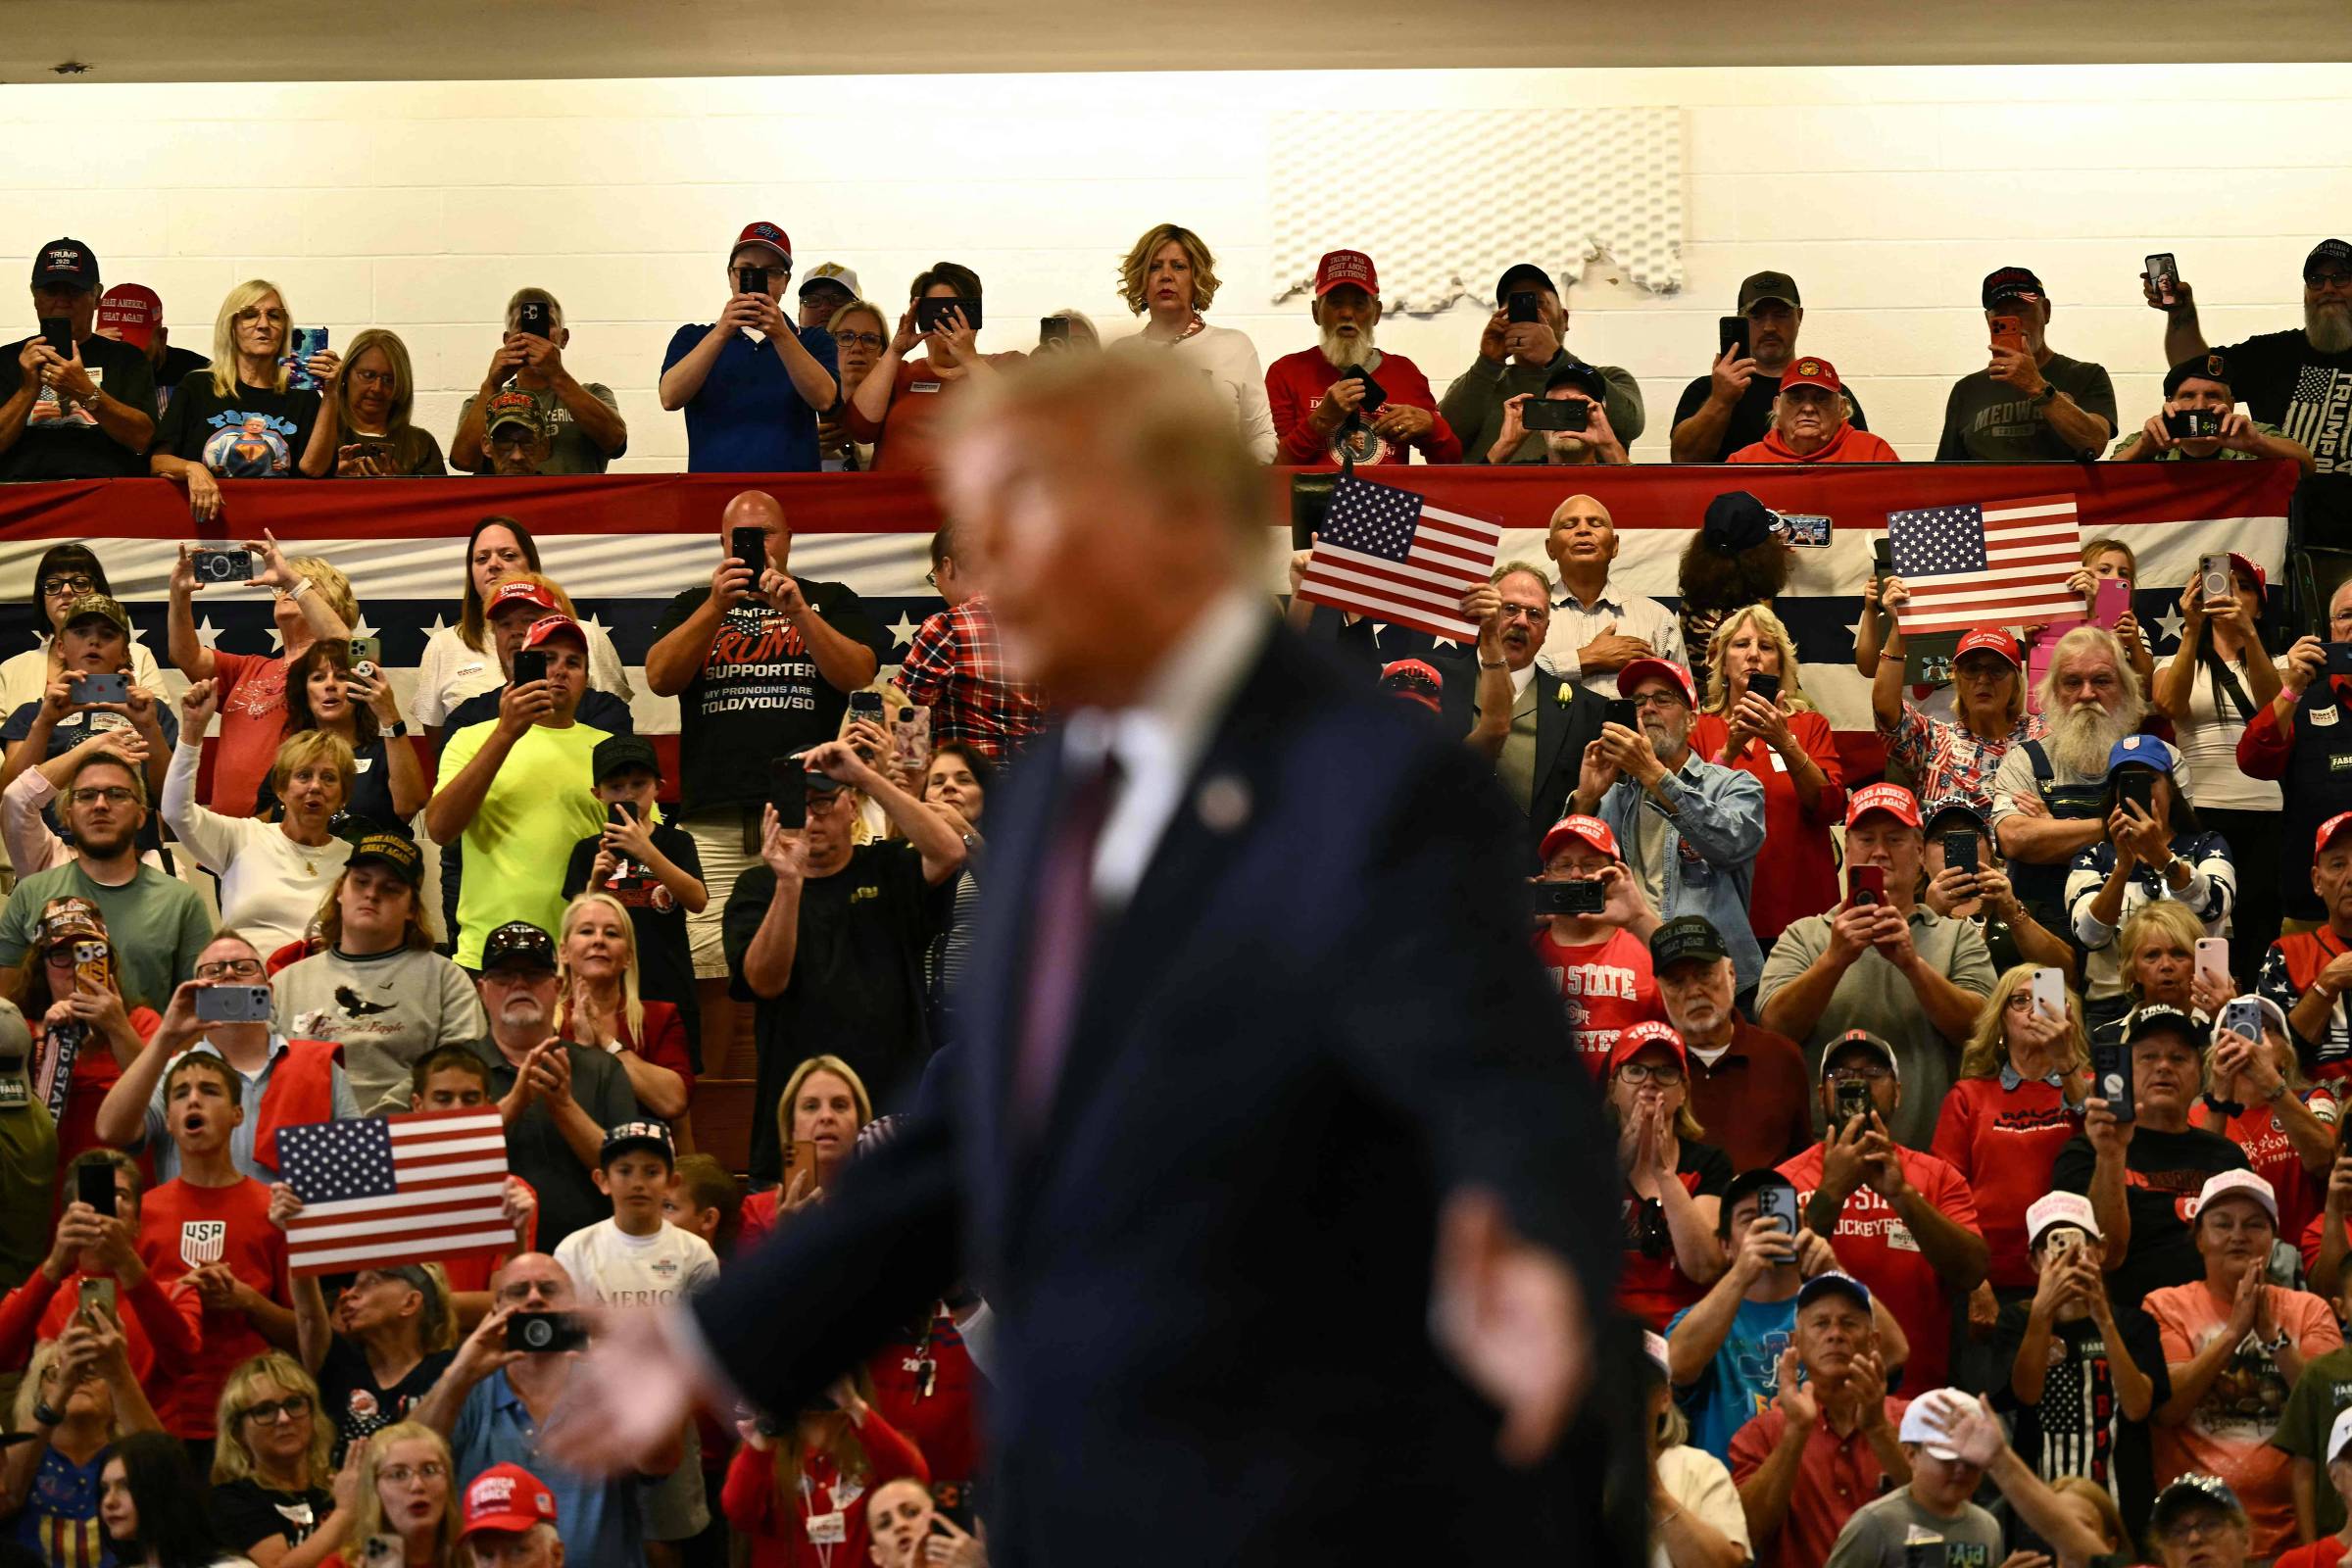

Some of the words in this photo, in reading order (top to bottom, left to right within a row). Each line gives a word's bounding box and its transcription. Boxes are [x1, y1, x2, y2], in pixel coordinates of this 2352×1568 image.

[48, 250, 78, 259] TRUMP
[1330, 256, 1351, 265] TRUMP
[1326, 270, 1368, 281] EVERYTHING
[1327, 263, 1346, 274] RIGHT
[1348, 263, 1368, 274] ABOUT
[706, 662, 817, 681] SUPPORTER
[705, 689, 720, 699] MY
[721, 685, 788, 697] PRONOUNS
[790, 685, 813, 696] ARE
[701, 696, 815, 715] TOLD/YOU/SO
[1852, 788, 1874, 805] MAKE
[1875, 786, 1910, 806] AMERICA
[1854, 795, 1881, 813] GREAT
[1883, 796, 1908, 812] AGAIN
[1570, 815, 1605, 835] AMERICA
[1576, 825, 1600, 840] AGAIN
[360, 844, 388, 854] GREAT
[1674, 923, 1708, 935] AMERICA
[1660, 938, 1681, 954] GREAT
[1683, 936, 1705, 948] AGAIN
[1567, 962, 1639, 1003] STATE
[1627, 1020, 1681, 1046] TRUMP
[186, 1223, 223, 1243] USA
